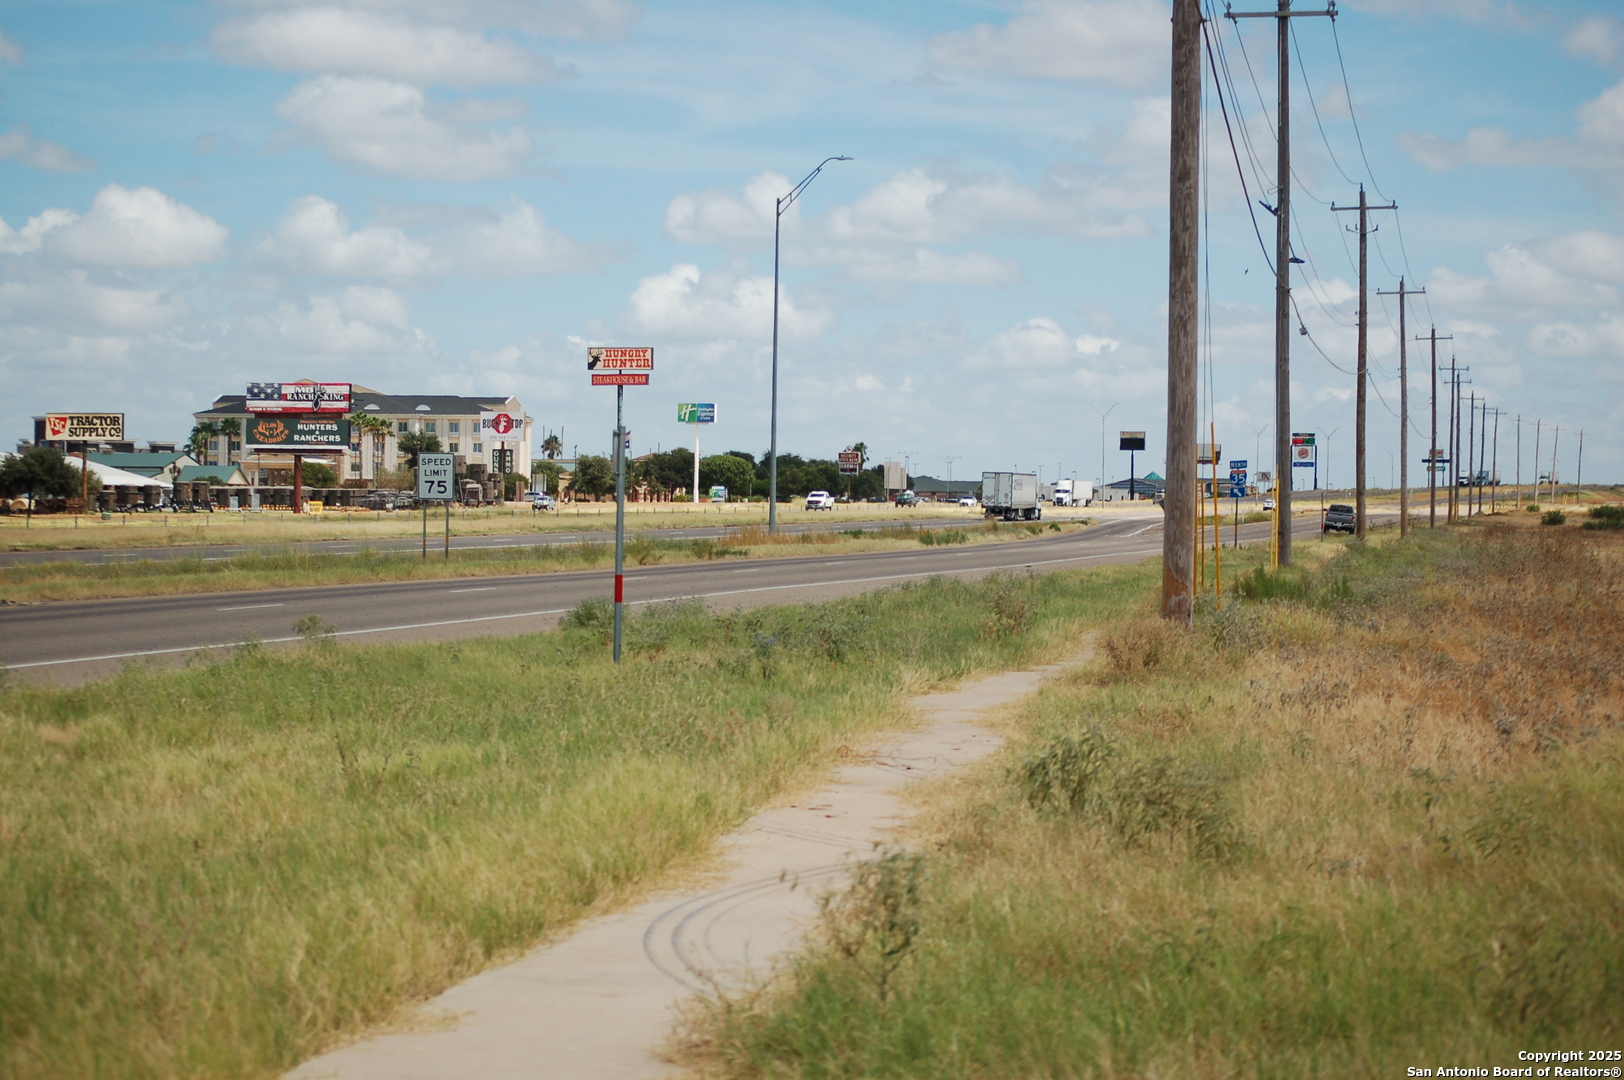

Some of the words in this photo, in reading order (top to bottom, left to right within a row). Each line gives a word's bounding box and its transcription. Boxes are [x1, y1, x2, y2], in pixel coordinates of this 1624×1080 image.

[605, 349, 648, 358] HUNGRY
[602, 358, 651, 368] HUNTER
[593, 375, 629, 384] STEAKHOUSE
[629, 376, 634, 384] &
[635, 375, 647, 384] BAR
[286, 393, 314, 401] RANCH
[322, 393, 344, 401] KING
[68, 416, 121, 426] TRACTOR
[482, 418, 501, 429] BUCK
[508, 418, 524, 429] STOP
[297, 423, 338, 431] HUNTERS
[68, 427, 108, 437] SUPPLY
[253, 428, 290, 443] CAZADORES
[293, 434, 341, 442] RANCHERS
[421, 458, 452, 466] SPEED
[424, 469, 448, 477] LIMIT
[1231, 474, 1245, 483] 35
[424, 480, 448, 494] 75
